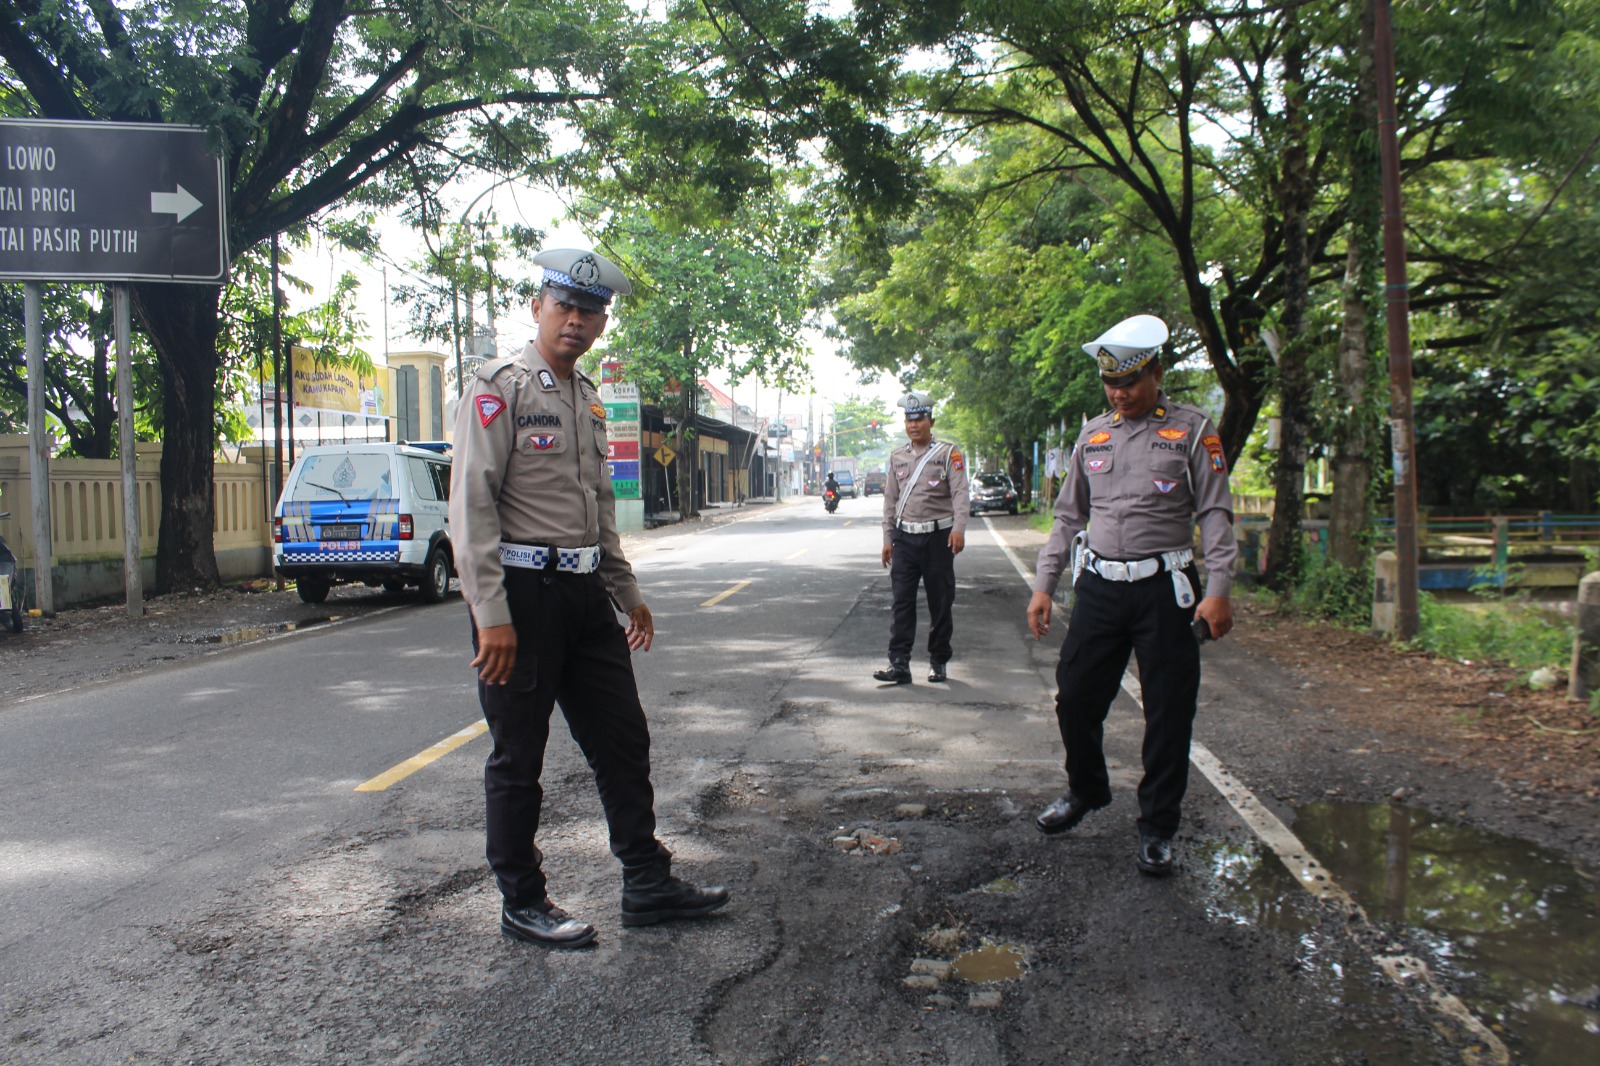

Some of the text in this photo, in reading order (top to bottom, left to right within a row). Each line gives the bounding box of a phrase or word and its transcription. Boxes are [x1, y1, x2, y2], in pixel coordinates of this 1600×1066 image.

[7, 145, 56, 171] LOWO
[31, 187, 76, 213] PRIGI
[0, 227, 138, 253] TAI PASIR PUTIH
[312, 372, 332, 381] SUDAH
[334, 372, 354, 390] LAPOR
[303, 384, 322, 393] KAMU
[517, 415, 561, 428] CANDRA
[1151, 441, 1188, 452] POLRI
[319, 540, 361, 551] POLISI
[506, 549, 531, 559] POLISI
